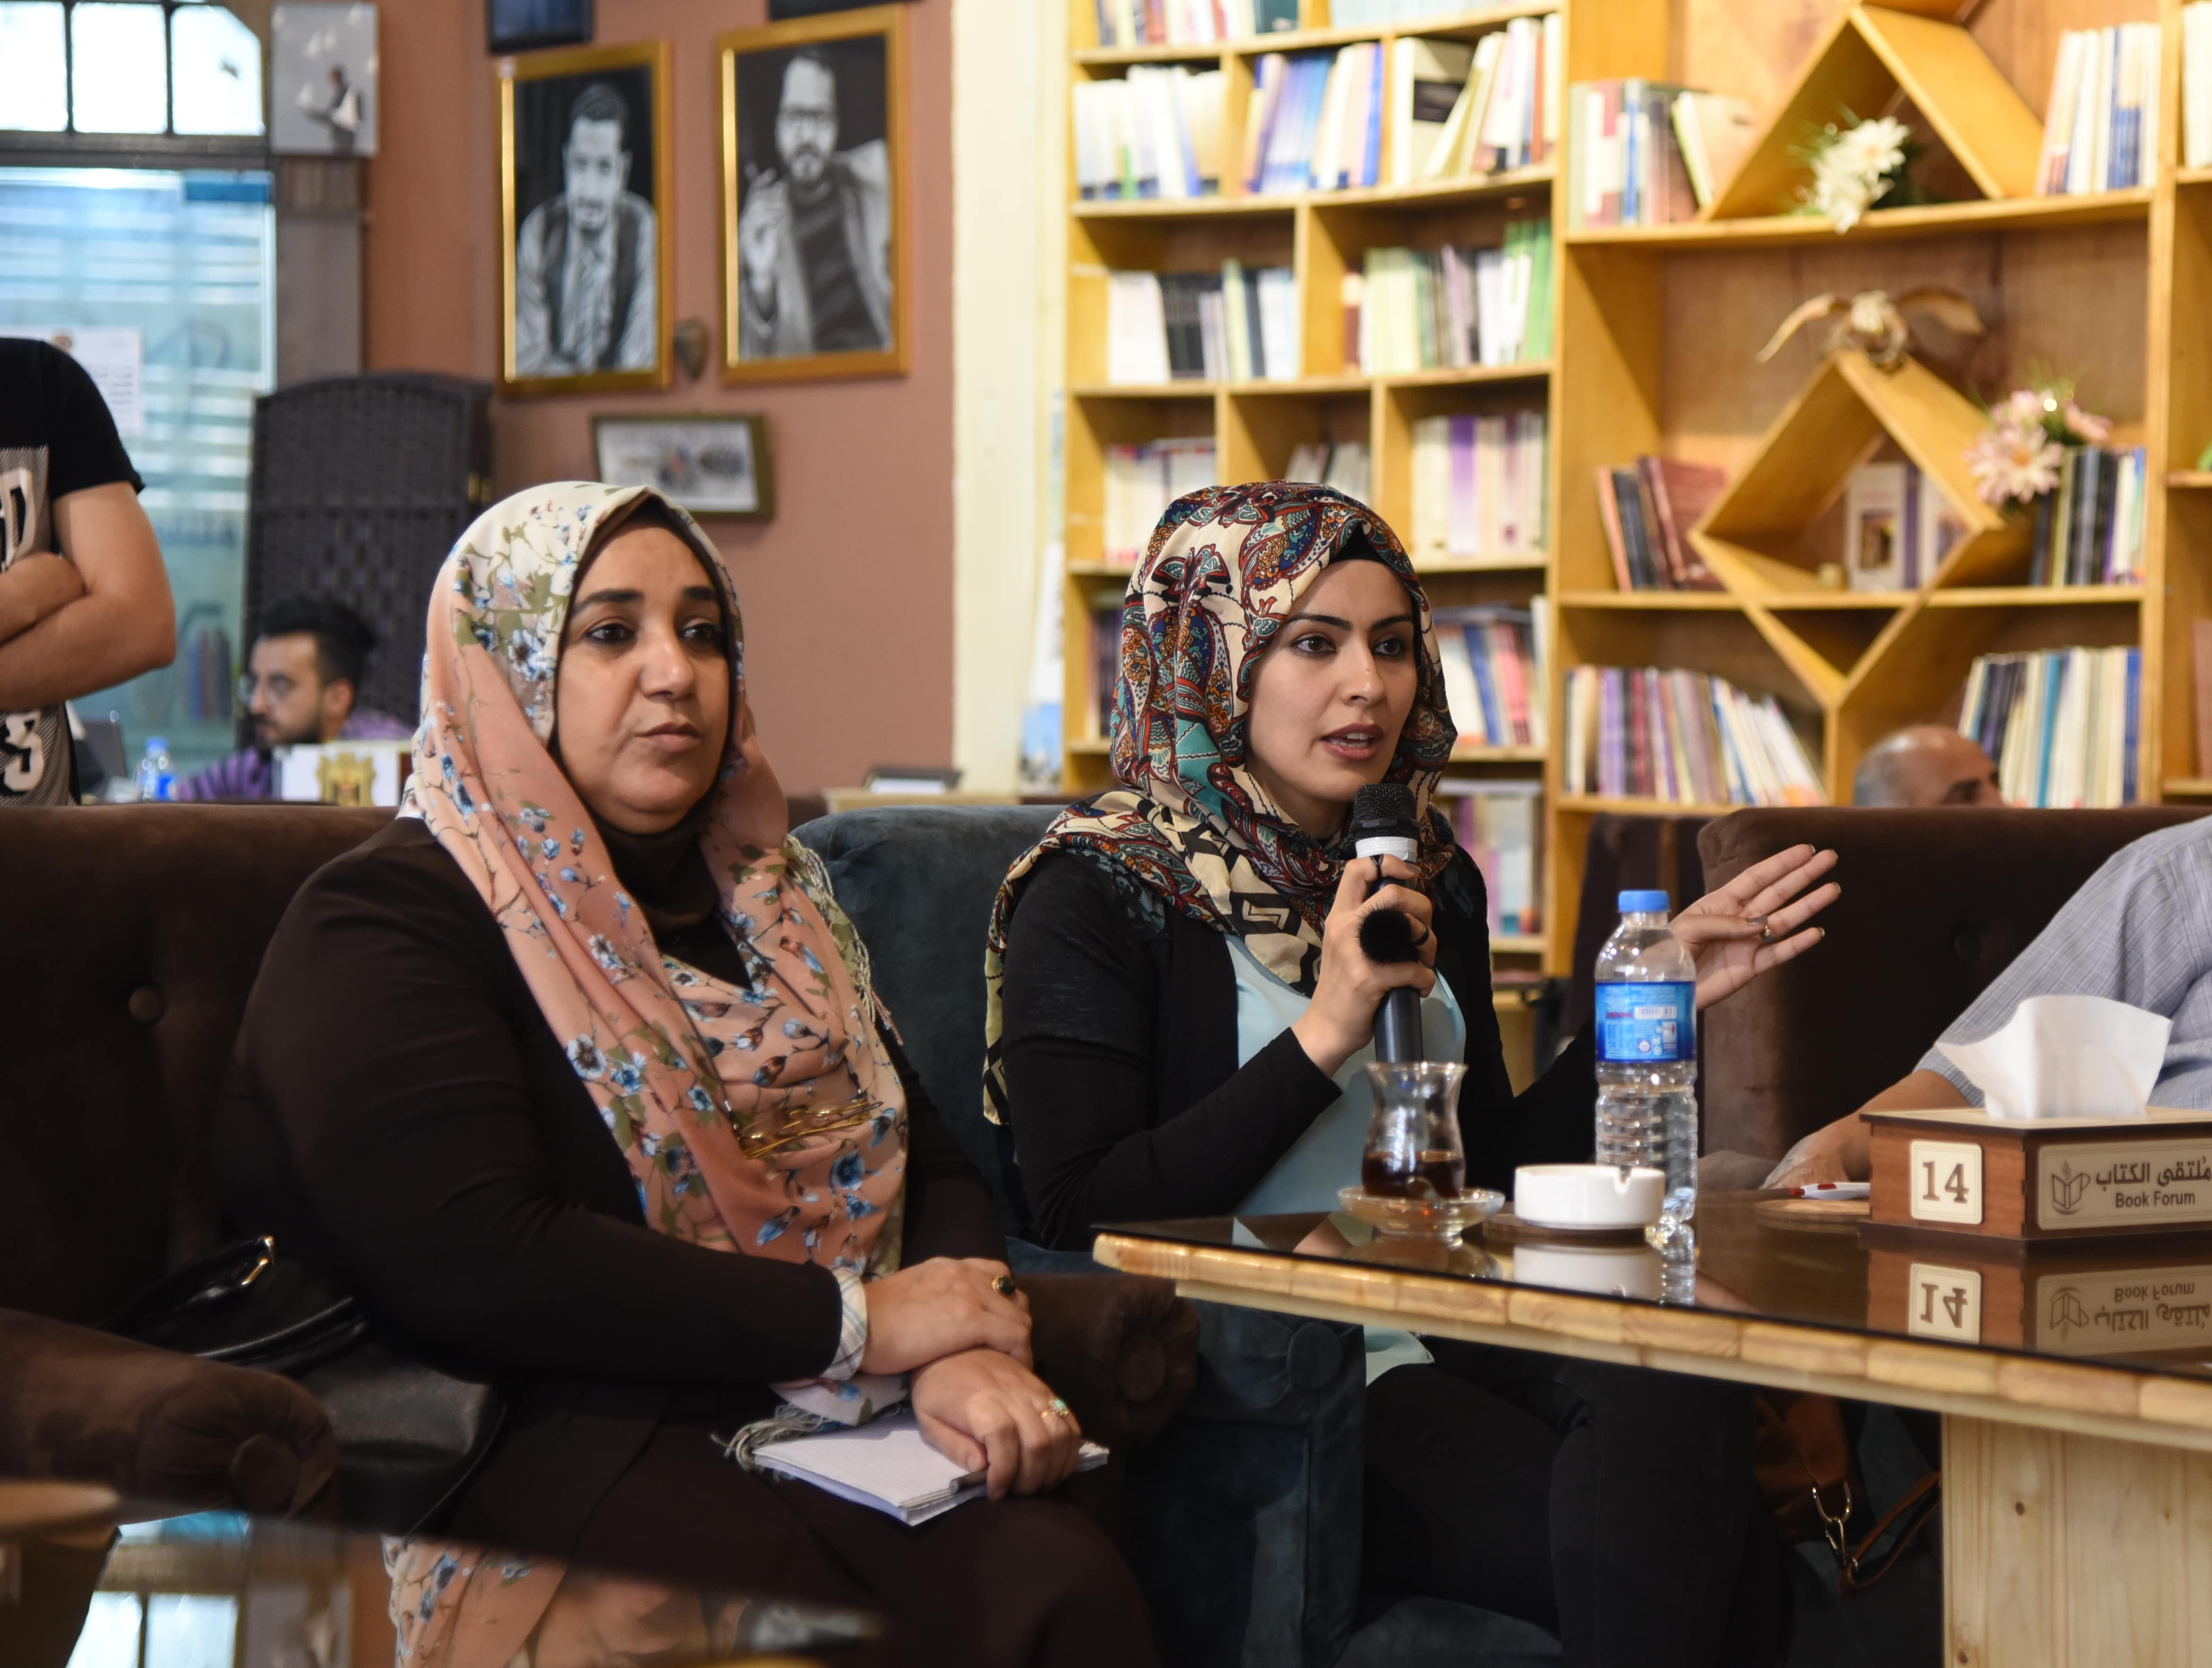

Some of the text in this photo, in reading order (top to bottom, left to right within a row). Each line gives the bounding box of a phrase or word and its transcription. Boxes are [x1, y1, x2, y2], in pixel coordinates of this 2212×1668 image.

[1922, 1161, 1970, 1204] 14
[2096, 1162, 2151, 1192] الكتاب
[2115, 1190, 2195, 1209] Book Forum
